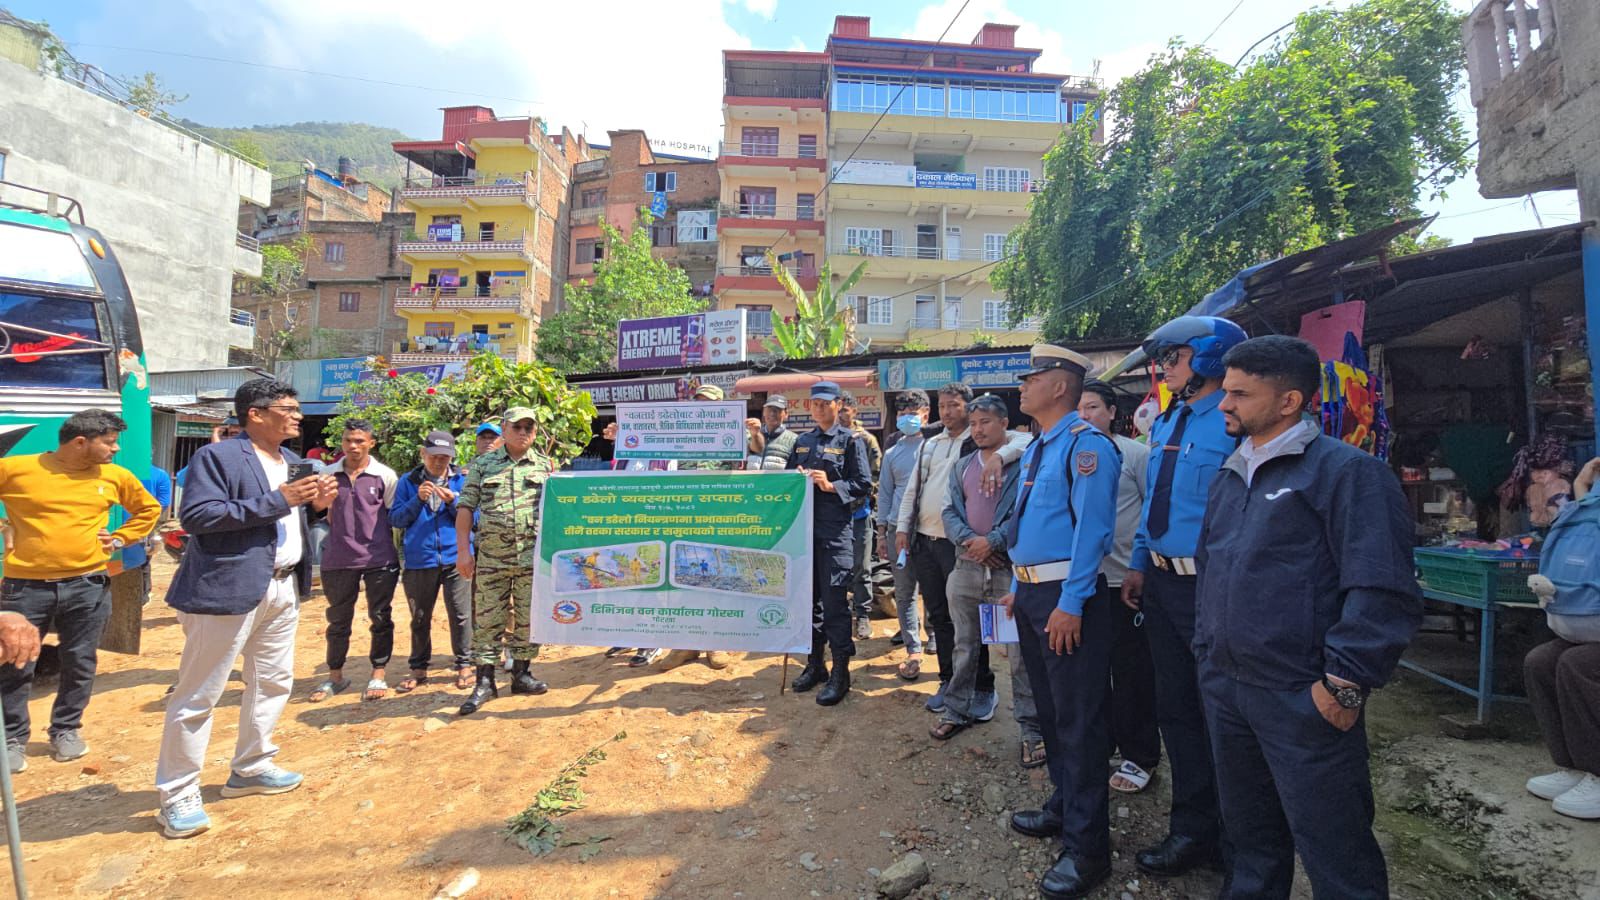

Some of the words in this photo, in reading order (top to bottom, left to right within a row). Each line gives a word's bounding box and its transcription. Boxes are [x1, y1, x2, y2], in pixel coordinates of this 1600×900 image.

[669, 141, 712, 153] HOSPITAL
[621, 326, 682, 348] XTREME
[621, 348, 652, 360] ENERGY
[654, 345, 681, 357] DRINK
[918, 370, 952, 380] TUBORG
[611, 385, 645, 402] ENERGY
[647, 383, 677, 400] DRINK
[557, 496, 577, 504] वन
[582, 493, 617, 504] डढेलो
[622, 495, 692, 504] व्यवस्थापन
[755, 494, 792, 503] २०८२
[614, 527, 650, 536] सरकार
[652, 527, 660, 536] र
[662, 526, 715, 538] समुदायको
[591, 604, 634, 615] डिभिजन
[638, 607, 656, 615] वन
[658, 606, 704, 617] कार्यालय
[707, 606, 744, 618] गोरखा
